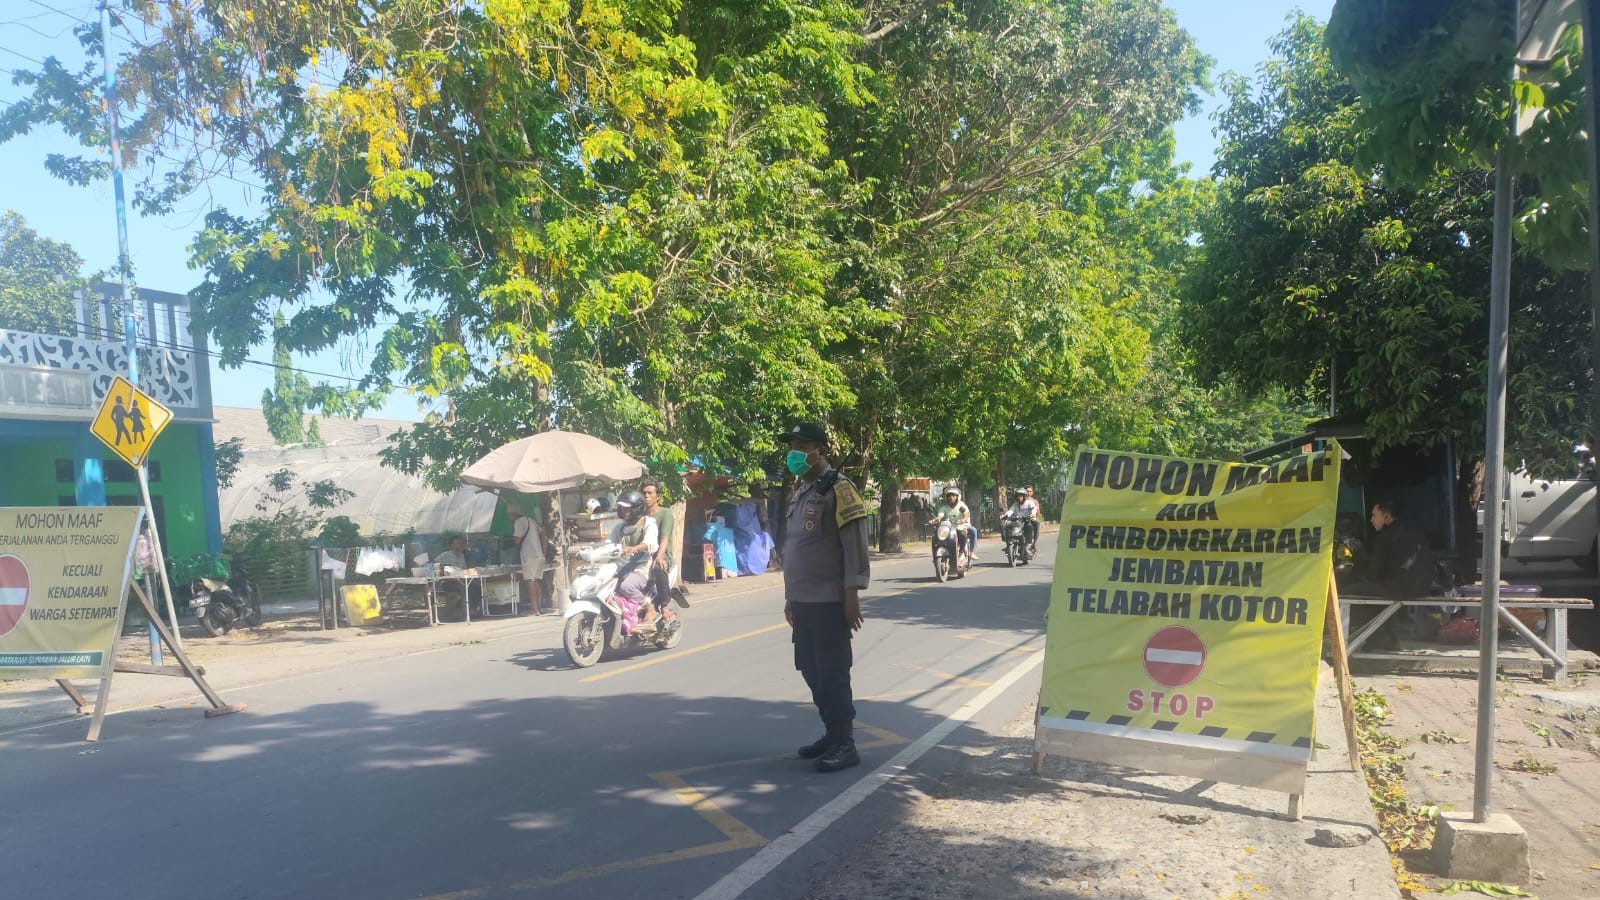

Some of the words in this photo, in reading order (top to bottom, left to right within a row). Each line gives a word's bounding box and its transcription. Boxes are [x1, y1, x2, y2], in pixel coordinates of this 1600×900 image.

[1073, 452, 1218, 497] MOHON
[1221, 443, 1332, 496] MAAF
[16, 513, 65, 528] MOHON
[68, 513, 103, 528] MAAF
[1156, 501, 1219, 522] ADA
[45, 535, 68, 545] ANDA
[70, 535, 120, 545] TERGANGGU
[1068, 525, 1322, 554] PEMBONGKARAN
[62, 565, 103, 577] KECUALI
[1108, 557, 1264, 588] JEMBATAN
[48, 586, 108, 599] KENDARAAN
[30, 608, 67, 621] WARGA
[69, 607, 118, 620] SETEMPAT
[1067, 588, 1191, 619] TELABAH
[1199, 593, 1308, 625] KOTOR
[1127, 689, 1215, 719] STOP
